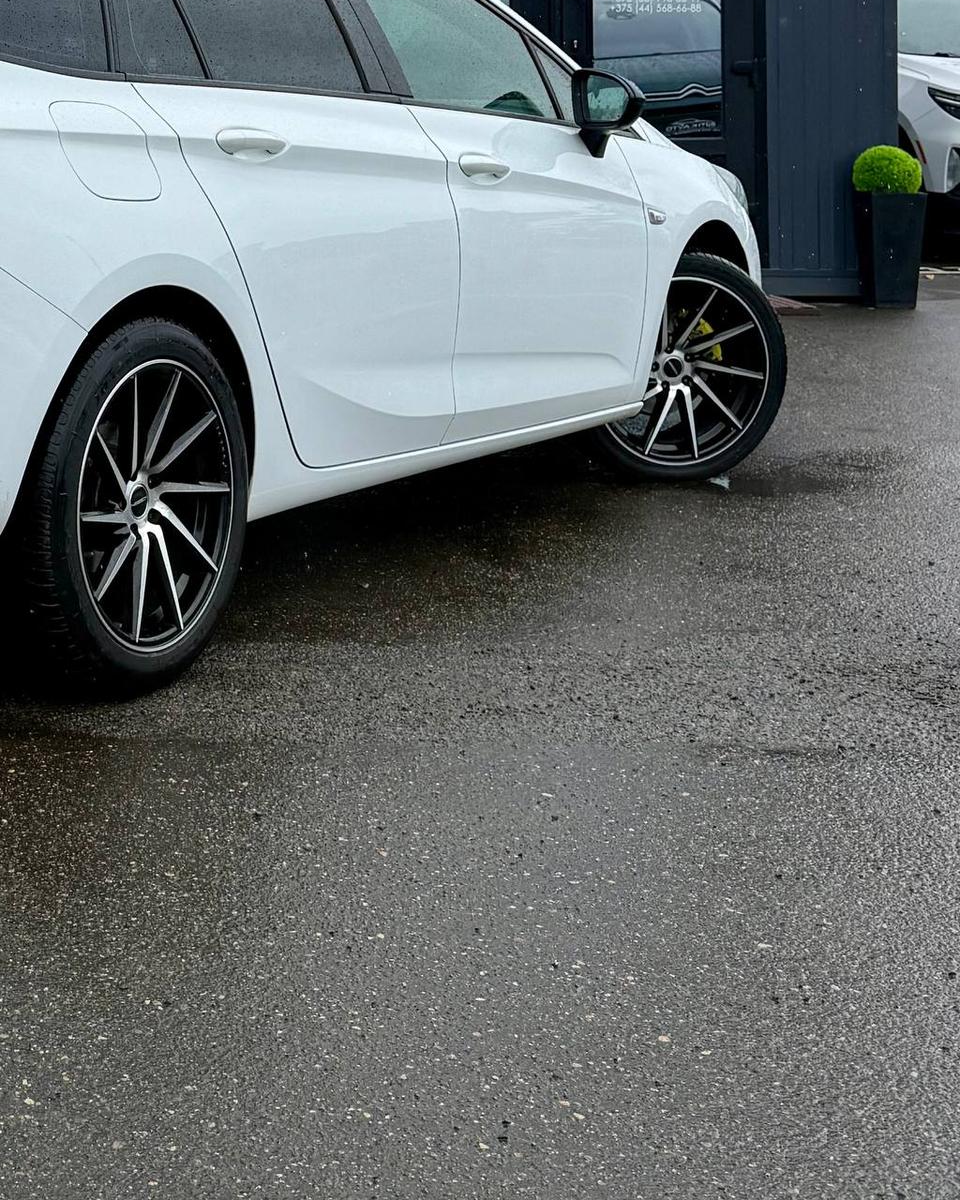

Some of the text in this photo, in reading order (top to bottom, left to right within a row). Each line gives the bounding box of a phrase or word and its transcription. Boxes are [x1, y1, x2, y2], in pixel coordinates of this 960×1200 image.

[610, 4, 701, 14] +375 (44) 568-66-88
